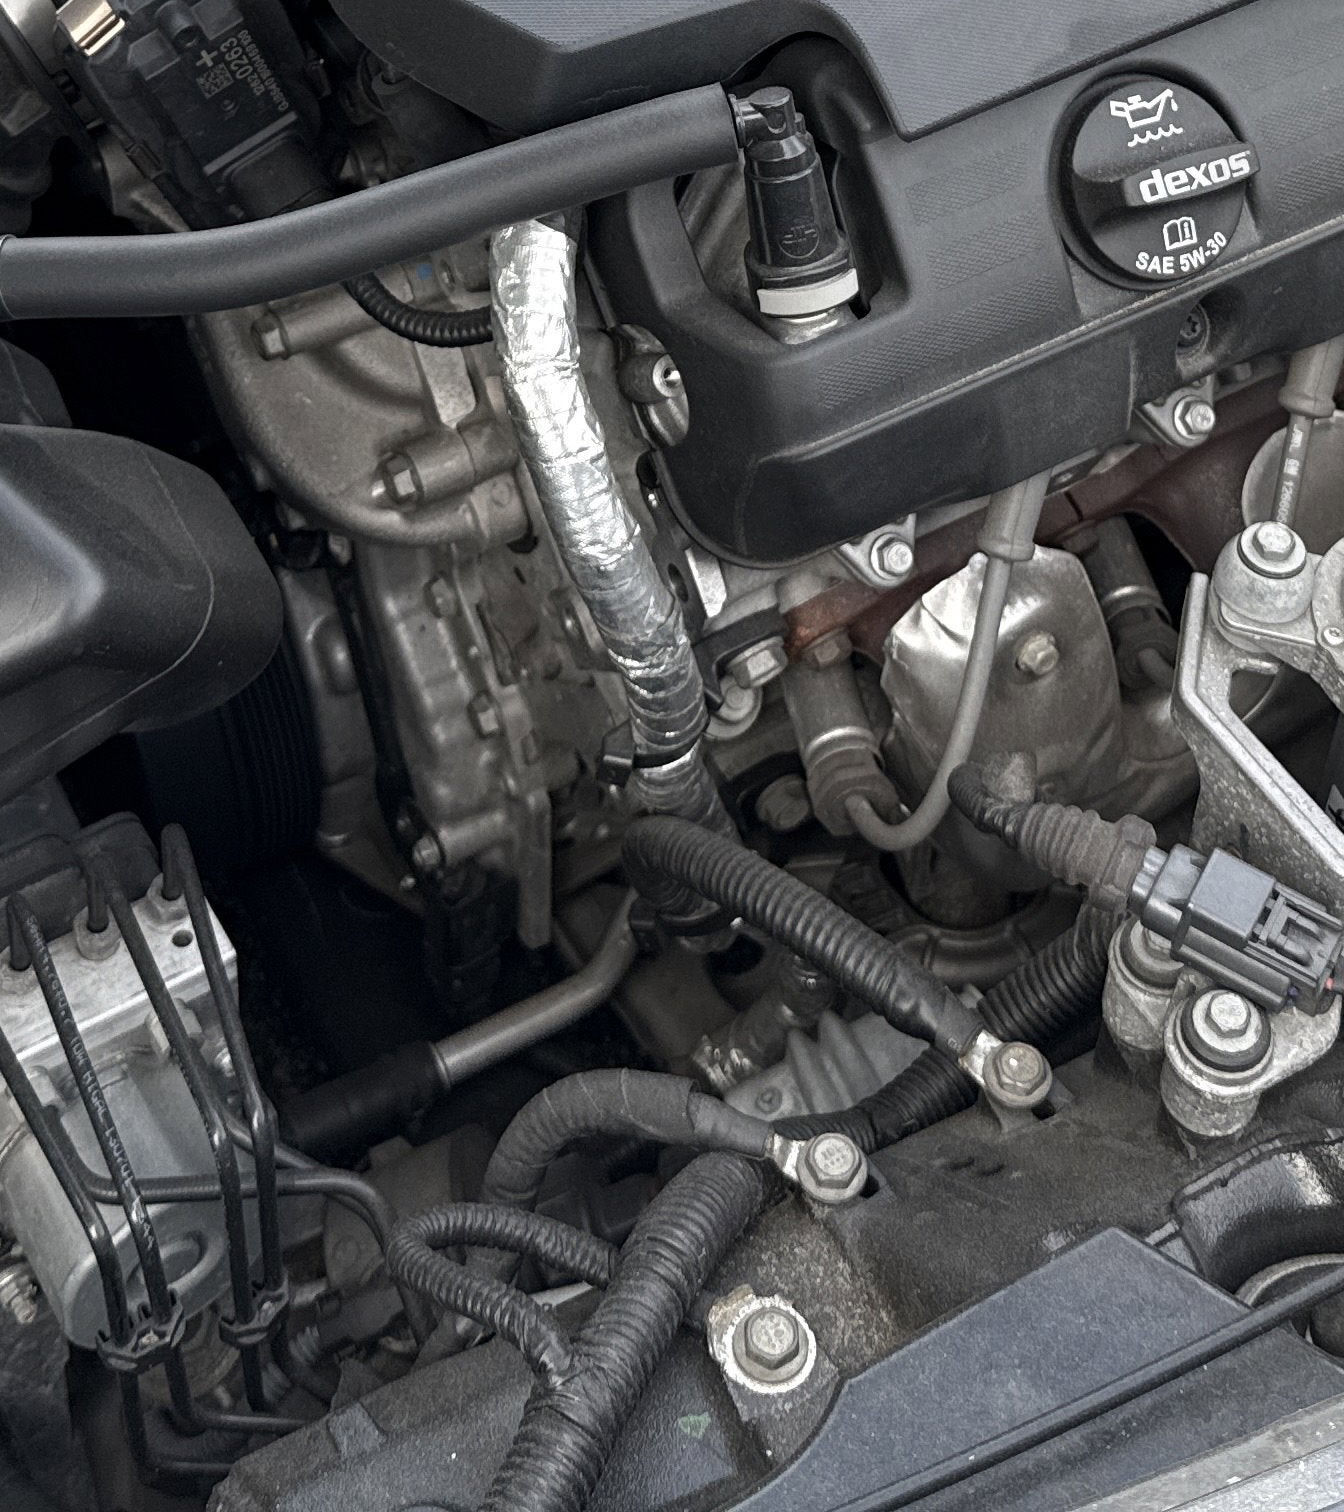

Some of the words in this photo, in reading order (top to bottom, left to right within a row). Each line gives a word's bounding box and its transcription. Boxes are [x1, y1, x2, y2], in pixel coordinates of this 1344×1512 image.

[1139, 150, 1251, 203] dexos
[1136, 251, 1174, 274] SAE
[1179, 231, 1227, 272] 5W-30
